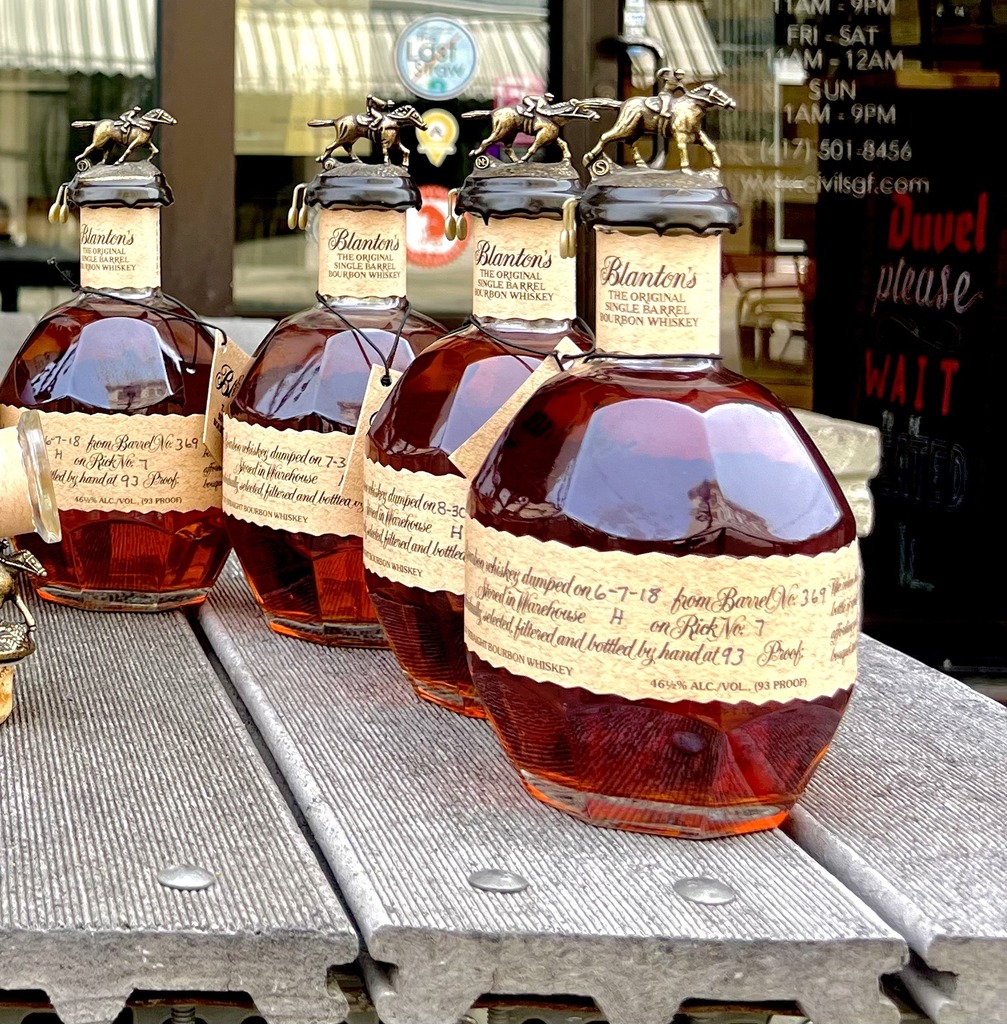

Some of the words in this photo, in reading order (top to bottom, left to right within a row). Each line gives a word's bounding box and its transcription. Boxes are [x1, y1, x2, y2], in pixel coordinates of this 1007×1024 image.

[787, 25, 818, 46] FRI
[839, 25, 880, 46] SAT
[846, 50, 904, 71] 12AM
[808, 79, 856, 100] SUN
[851, 104, 896, 124] 9PM
[818, 140, 912, 161] 501-8456
[888, 192, 987, 254] Duvel
[81, 223, 134, 246] Blanton's
[328, 228, 400, 251] Blanton's
[475, 240, 552, 268] Blanton's
[328, 270, 367, 278] BOURBON
[369, 271, 400, 279] WHISKEY
[480, 269, 494, 278] THE
[497, 271, 542, 280] ORIGINAL
[601, 255, 698, 289] Blanton's
[474, 289, 507, 299] BOURBON
[510, 292, 554, 301] WHISKEY
[477, 279, 504, 289] SINGLE
[506, 281, 546, 291] BARREL
[871, 256, 983, 316] please
[609, 290, 628, 300] THE
[630, 292, 685, 303] ORIGINAL
[605, 301, 639, 313] SINGLE
[643, 304, 690, 315] BARREL
[600, 312, 644, 325] BOURBON
[647, 315, 699, 327] WHISKEY
[866, 348, 959, 416] WAIT
[86, 435, 116, 451] from
[111, 435, 156, 451] Barrel
[175, 438, 199, 450] 369
[86, 453, 120, 470] Rick
[270, 445, 310, 466] dumped
[78, 472, 108, 485] hand
[122, 475, 139, 487] 93
[262, 461, 318, 484] Warehouse
[263, 484, 298, 500] filtered
[388, 488, 424, 512] dumped
[274, 513, 308, 523] WHISKEY
[380, 504, 432, 533] Warehouse
[451, 525, 463, 539] H
[392, 563, 423, 577] WHISKEY
[486, 557, 521, 586] whiskey
[521, 567, 576, 598] dumped
[594, 584, 661, 603] 6-7-18
[670, 586, 712, 614] from
[710, 587, 775, 613] Barrel
[801, 588, 826, 606] 369
[513, 585, 586, 623] Warehouse
[609, 607, 624, 625] H
[669, 614, 719, 641] Rick
[513, 618, 559, 647] filtered
[587, 634, 638, 660] bottled
[656, 642, 705, 665] hand
[722, 648, 744, 665] 93
[488, 641, 525, 664] BOURBON
[527, 657, 573, 676] WHISKEY
[755, 682, 770, 693] (93
[773, 678, 808, 690] PROOF)
